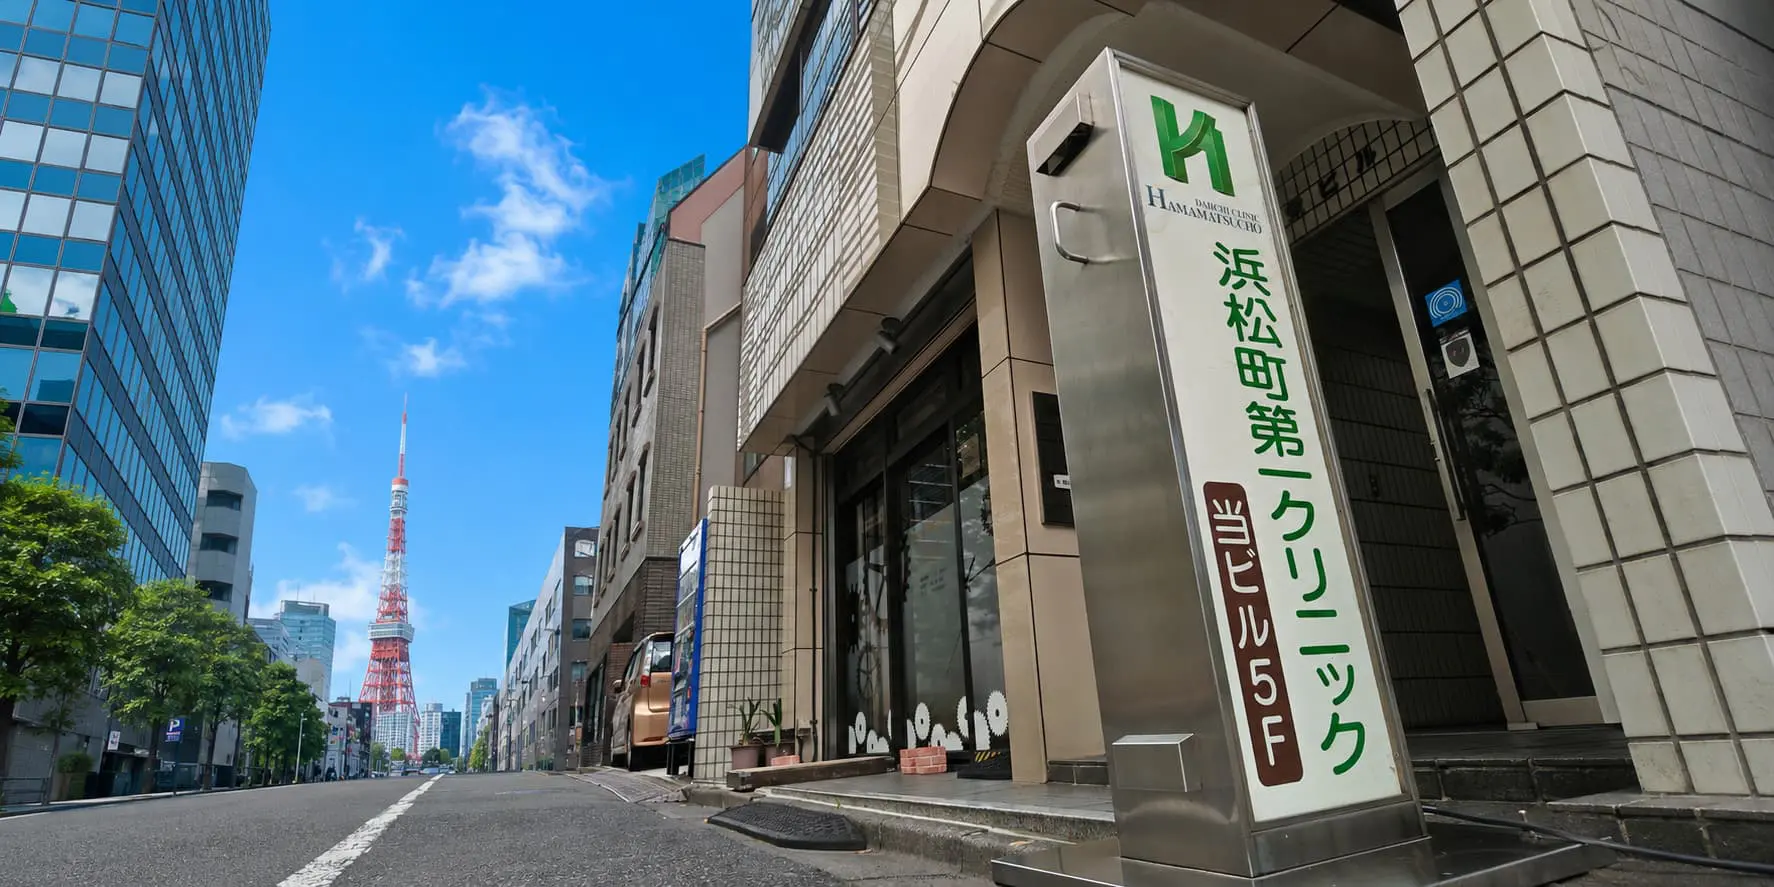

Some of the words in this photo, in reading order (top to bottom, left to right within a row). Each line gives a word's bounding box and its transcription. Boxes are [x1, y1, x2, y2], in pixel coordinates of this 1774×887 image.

[1145, 184, 1262, 234] HAMAMATSUCHO
[1232, 208, 1259, 222] CLINIC
[1213, 242, 1366, 775] 浜松町第一クリニック
[1213, 499, 1286, 767] 当ビル5F
